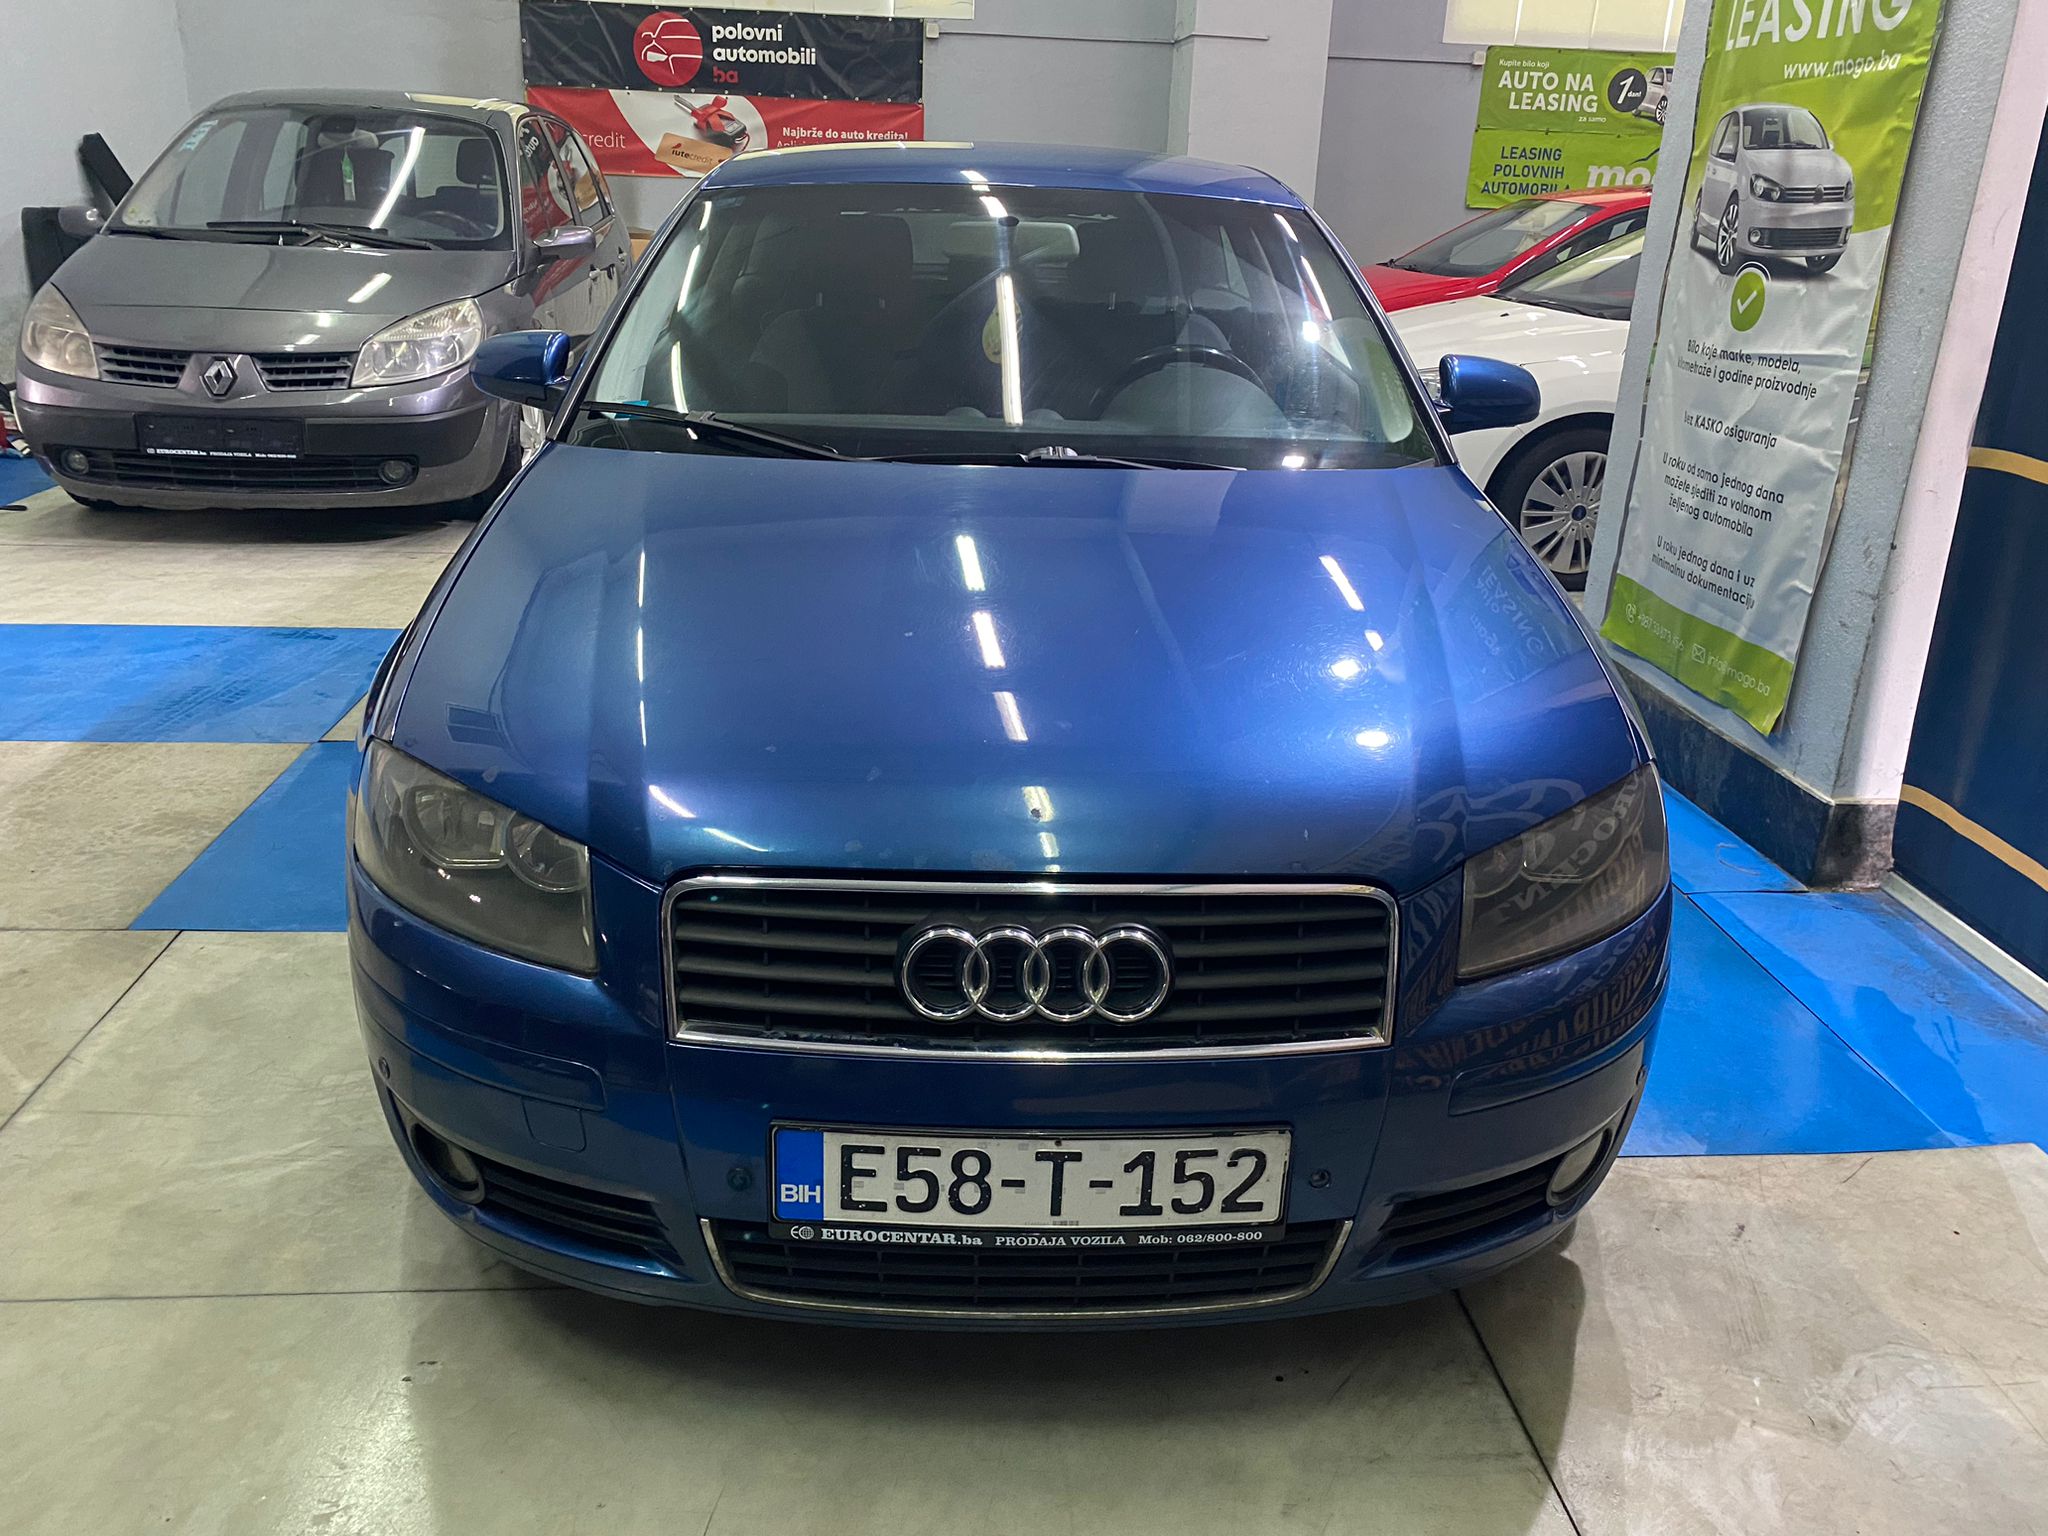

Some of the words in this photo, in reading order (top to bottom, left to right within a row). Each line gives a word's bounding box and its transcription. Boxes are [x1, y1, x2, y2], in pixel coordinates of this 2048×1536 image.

[712, 22, 783, 43] polovni
[1725, 0, 1913, 51] LEASING
[712, 45, 816, 66] automobili
[1499, 58, 1521, 68] Kupite
[1522, 60, 1536, 68] bilo
[1537, 60, 1549, 70] koji
[1784, 50, 1902, 79] www.mogo.ba
[1498, 70, 1559, 91] AUTO
[1565, 73, 1595, 92] NA
[1617, 76, 1634, 104] 1
[1508, 92, 1598, 113] LEASING
[582, 131, 626, 149] redit
[783, 127, 823, 139] Najbrže
[825, 128, 839, 139] do
[841, 130, 865, 140] auto
[1500, 146, 1562, 161] LEASING
[1493, 164, 1565, 179] POLOVNIH
[1687, 339, 1700, 354] Bilo
[1701, 343, 1718, 359] koje
[1719, 349, 1754, 366] marke,
[1757, 355, 1802, 374] modela,
[1713, 365, 1718, 379] i
[1718, 367, 1754, 385] godine
[1754, 376, 1817, 401] proizvodnje
[1694, 415, 1723, 434] KASKO
[1724, 425, 1778, 450] osiguranja
[1662, 452, 1668, 464] U
[1668, 454, 1686, 471] roku
[1686, 462, 1696, 475] od
[1697, 468, 1719, 484] samo
[1720, 472, 1754, 498] jednog
[1756, 483, 1785, 504] dana
[1664, 472, 1691, 494] možete
[1691, 481, 1715, 503] sjediti
[1717, 494, 1728, 507] za
[1730, 497, 1772, 522] volanom
[1669, 493, 1700, 520] željenog
[1702, 510, 1753, 537] automobila
[1657, 535, 1663, 548] U
[1663, 540, 1677, 556] roku
[1677, 546, 1708, 571] jednog
[1710, 560, 1734, 581] dana
[1736, 569, 1741, 584] i
[1743, 574, 1756, 588] uz
[1652, 552, 1686, 579] minimalnu
[1686, 571, 1755, 610] dokumentaciju
[780, 1183, 821, 1204] BIH
[840, 1143, 1268, 1217] E58-T-152
[821, 1228, 983, 1246] EUROCENTAR.ba
[995, 1236, 1067, 1247] PRODAJA
[1071, 1235, 1126, 1246] VOZILA
[1138, 1234, 1173, 1245] Mob:
[1177, 1231, 1263, 1244] 062/800-800
